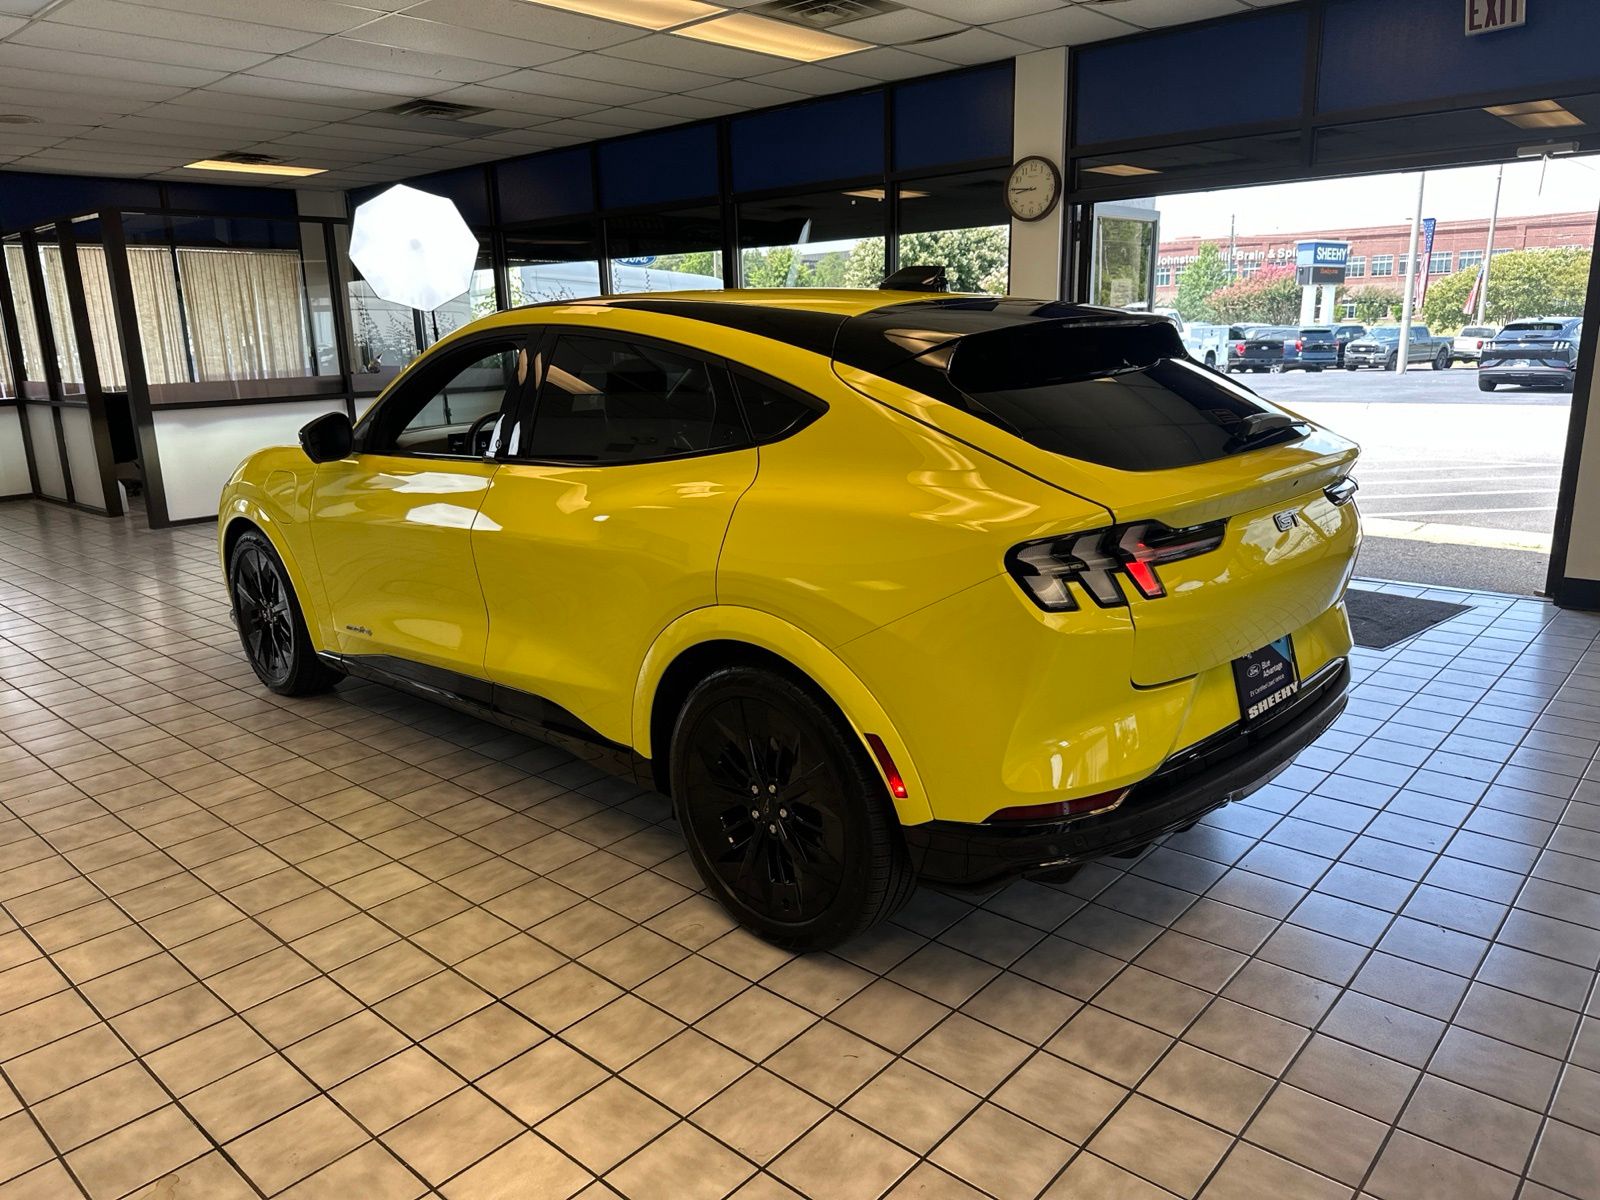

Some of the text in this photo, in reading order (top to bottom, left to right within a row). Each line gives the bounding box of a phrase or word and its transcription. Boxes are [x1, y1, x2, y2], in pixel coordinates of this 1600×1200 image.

[1236, 250, 1265, 261] Brain
[1267, 248, 1276, 259] &
[1277, 247, 1297, 260] Spi
[1316, 246, 1346, 260] SHEEHY
[1248, 680, 1298, 719] SHEEHY
